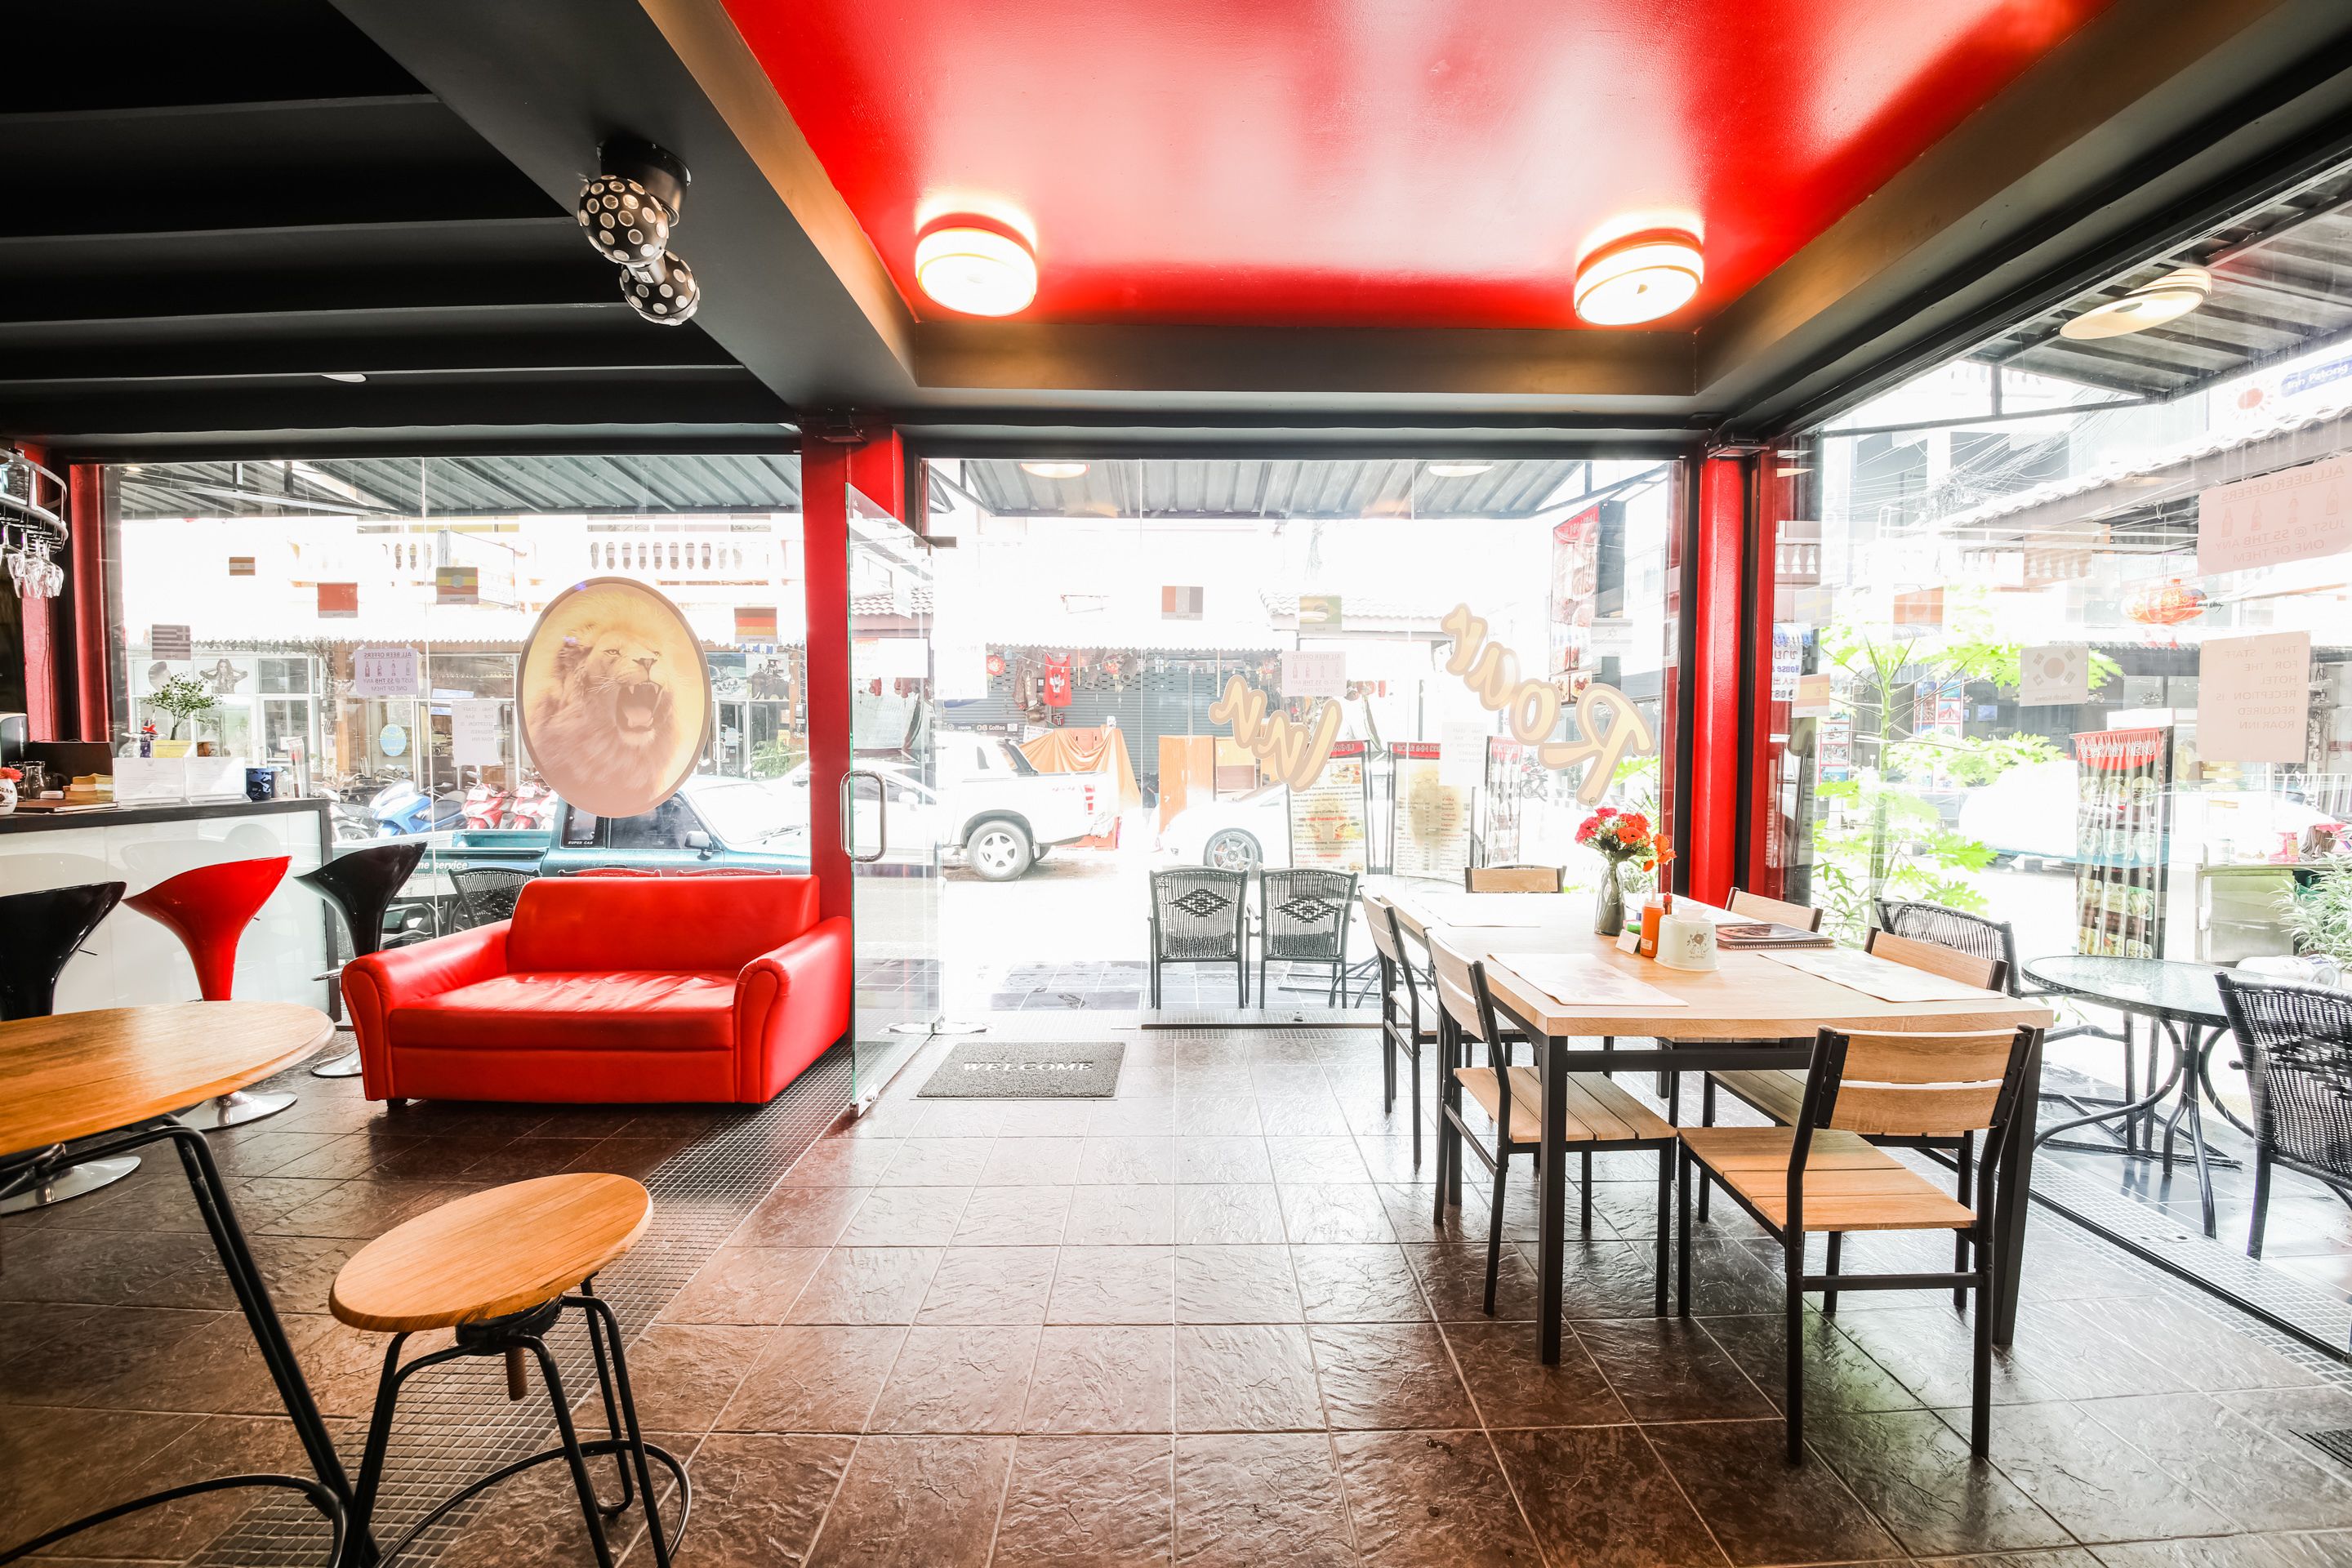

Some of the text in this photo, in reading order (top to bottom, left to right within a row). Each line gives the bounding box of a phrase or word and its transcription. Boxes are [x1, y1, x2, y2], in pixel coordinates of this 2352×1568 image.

[2308, 363, 2349, 382] Patong
[2126, 740, 2156, 756] MENU
[434, 859, 469, 870] service
[963, 1062, 1095, 1071] WELCOME
